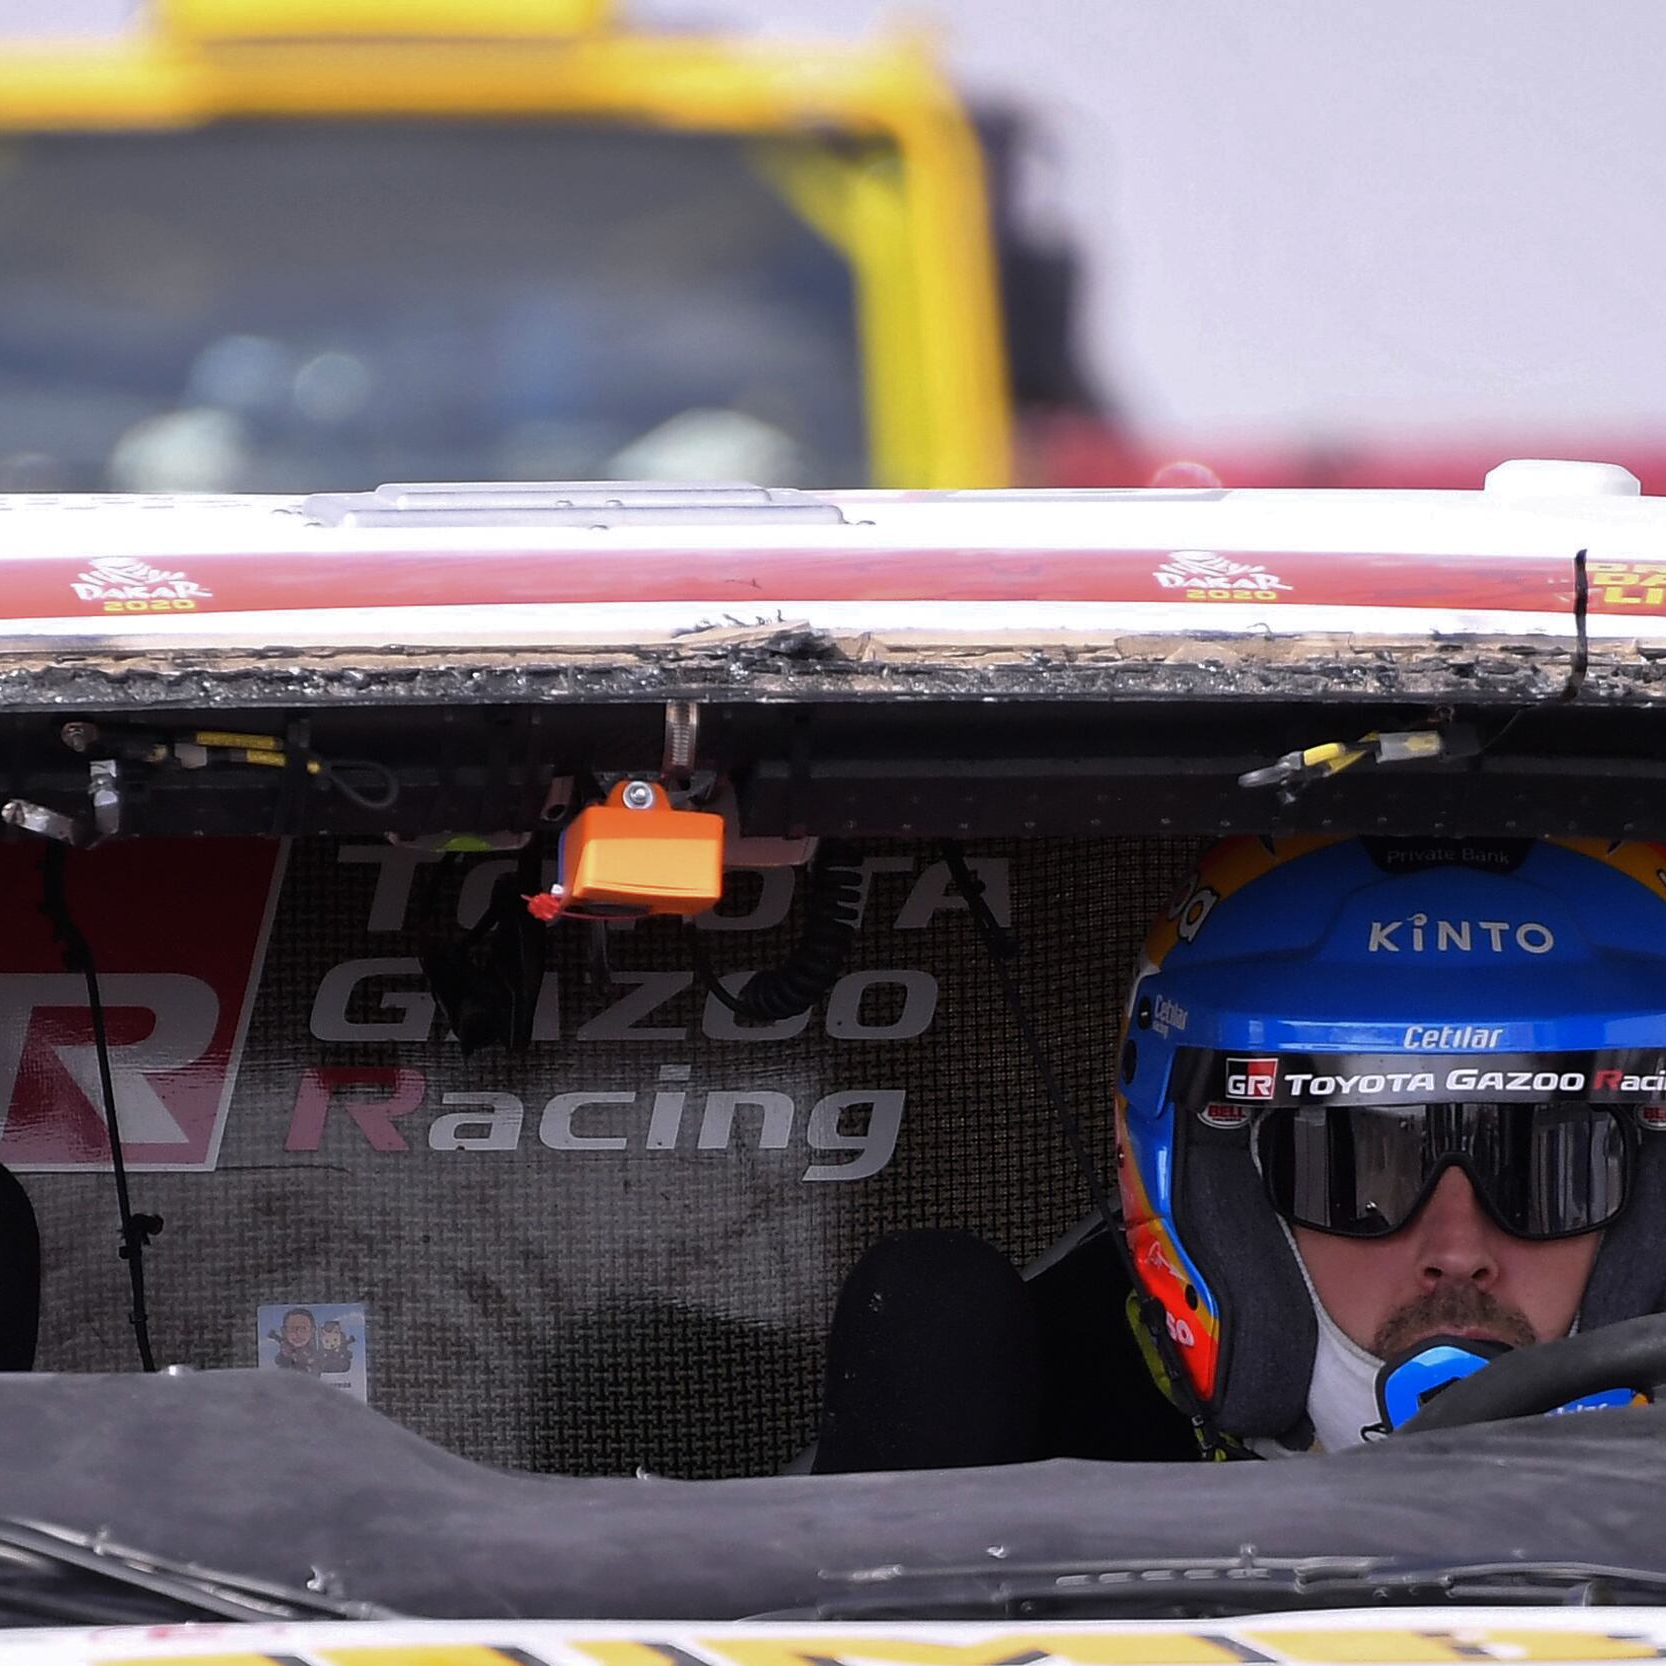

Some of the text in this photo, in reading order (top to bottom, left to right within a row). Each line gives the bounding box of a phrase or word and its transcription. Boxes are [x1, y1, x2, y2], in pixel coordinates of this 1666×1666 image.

[103, 600, 195, 612] 2020
[1186, 589, 1277, 600] 2020
[309, 957, 939, 1042] GZOO
[1403, 1025, 1503, 1050] Cetilar
[1227, 1075, 1273, 1096] GR
[1284, 1073, 1435, 1096] TOYOTA
[1445, 1067, 1585, 1092] GAZOO
[284, 1064, 906, 1181] Racing
